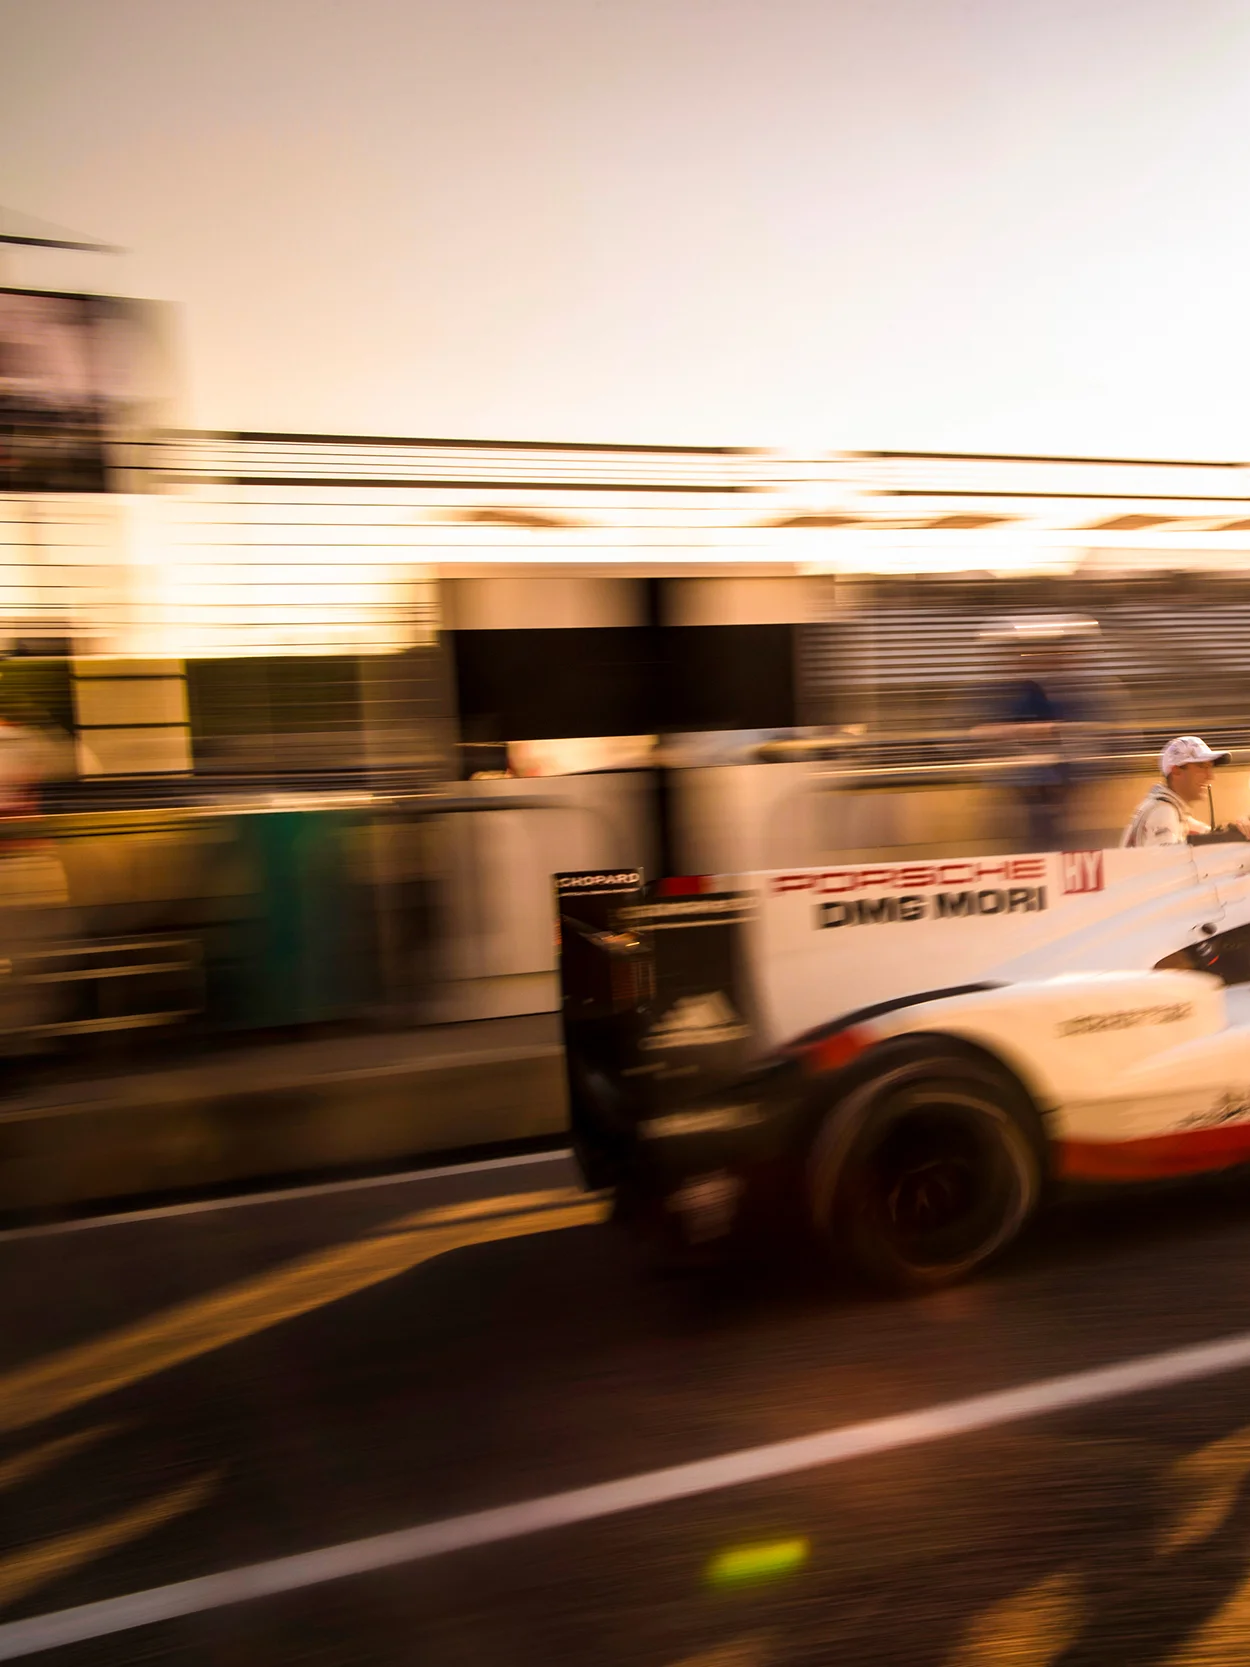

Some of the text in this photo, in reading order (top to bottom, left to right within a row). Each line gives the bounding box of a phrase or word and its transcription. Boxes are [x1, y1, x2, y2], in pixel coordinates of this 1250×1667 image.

[556, 872, 640, 888] CHOPARD
[771, 858, 1046, 898] PORSCHE
[814, 886, 1048, 930] DMG MORI
